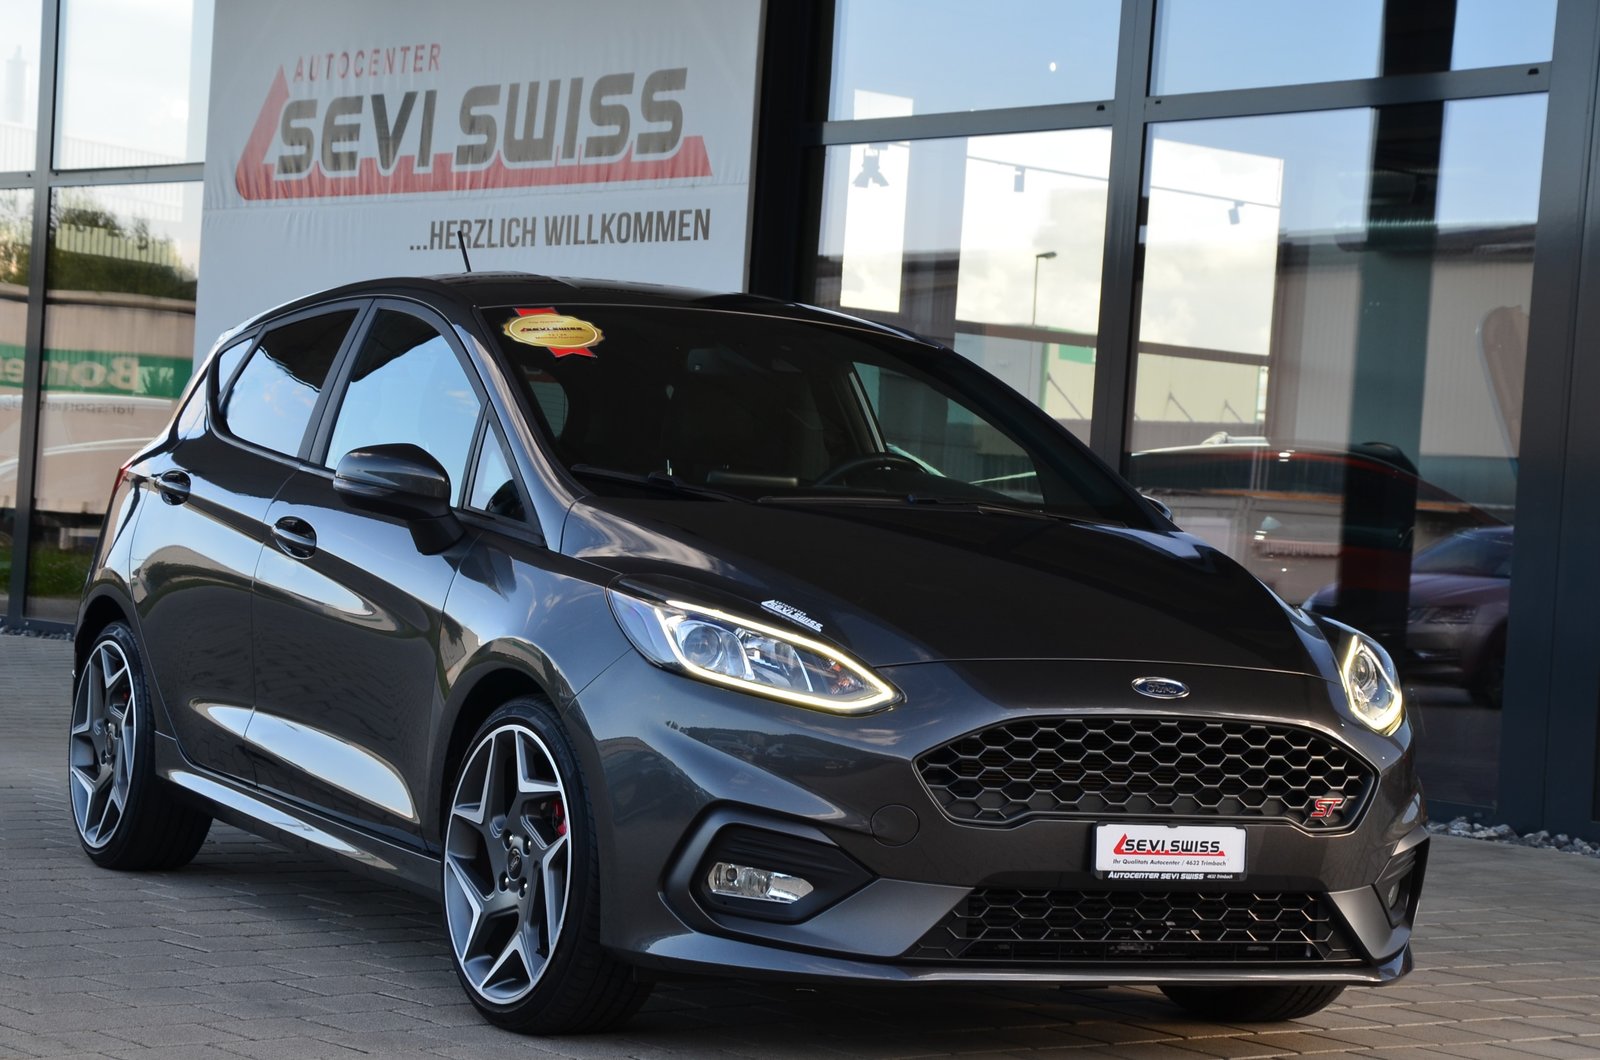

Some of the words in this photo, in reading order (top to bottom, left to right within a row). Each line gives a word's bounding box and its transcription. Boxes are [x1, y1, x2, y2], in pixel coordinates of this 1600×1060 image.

[293, 44, 441, 82] AUTOCENTER
[276, 90, 437, 175] SEVI
[456, 67, 688, 166] SWISS
[544, 208, 711, 246] WILLKOMMEN
[1311, 798, 1342, 817] ST
[1125, 839, 1165, 852] SEVI
[1170, 840, 1220, 853] SWISS
